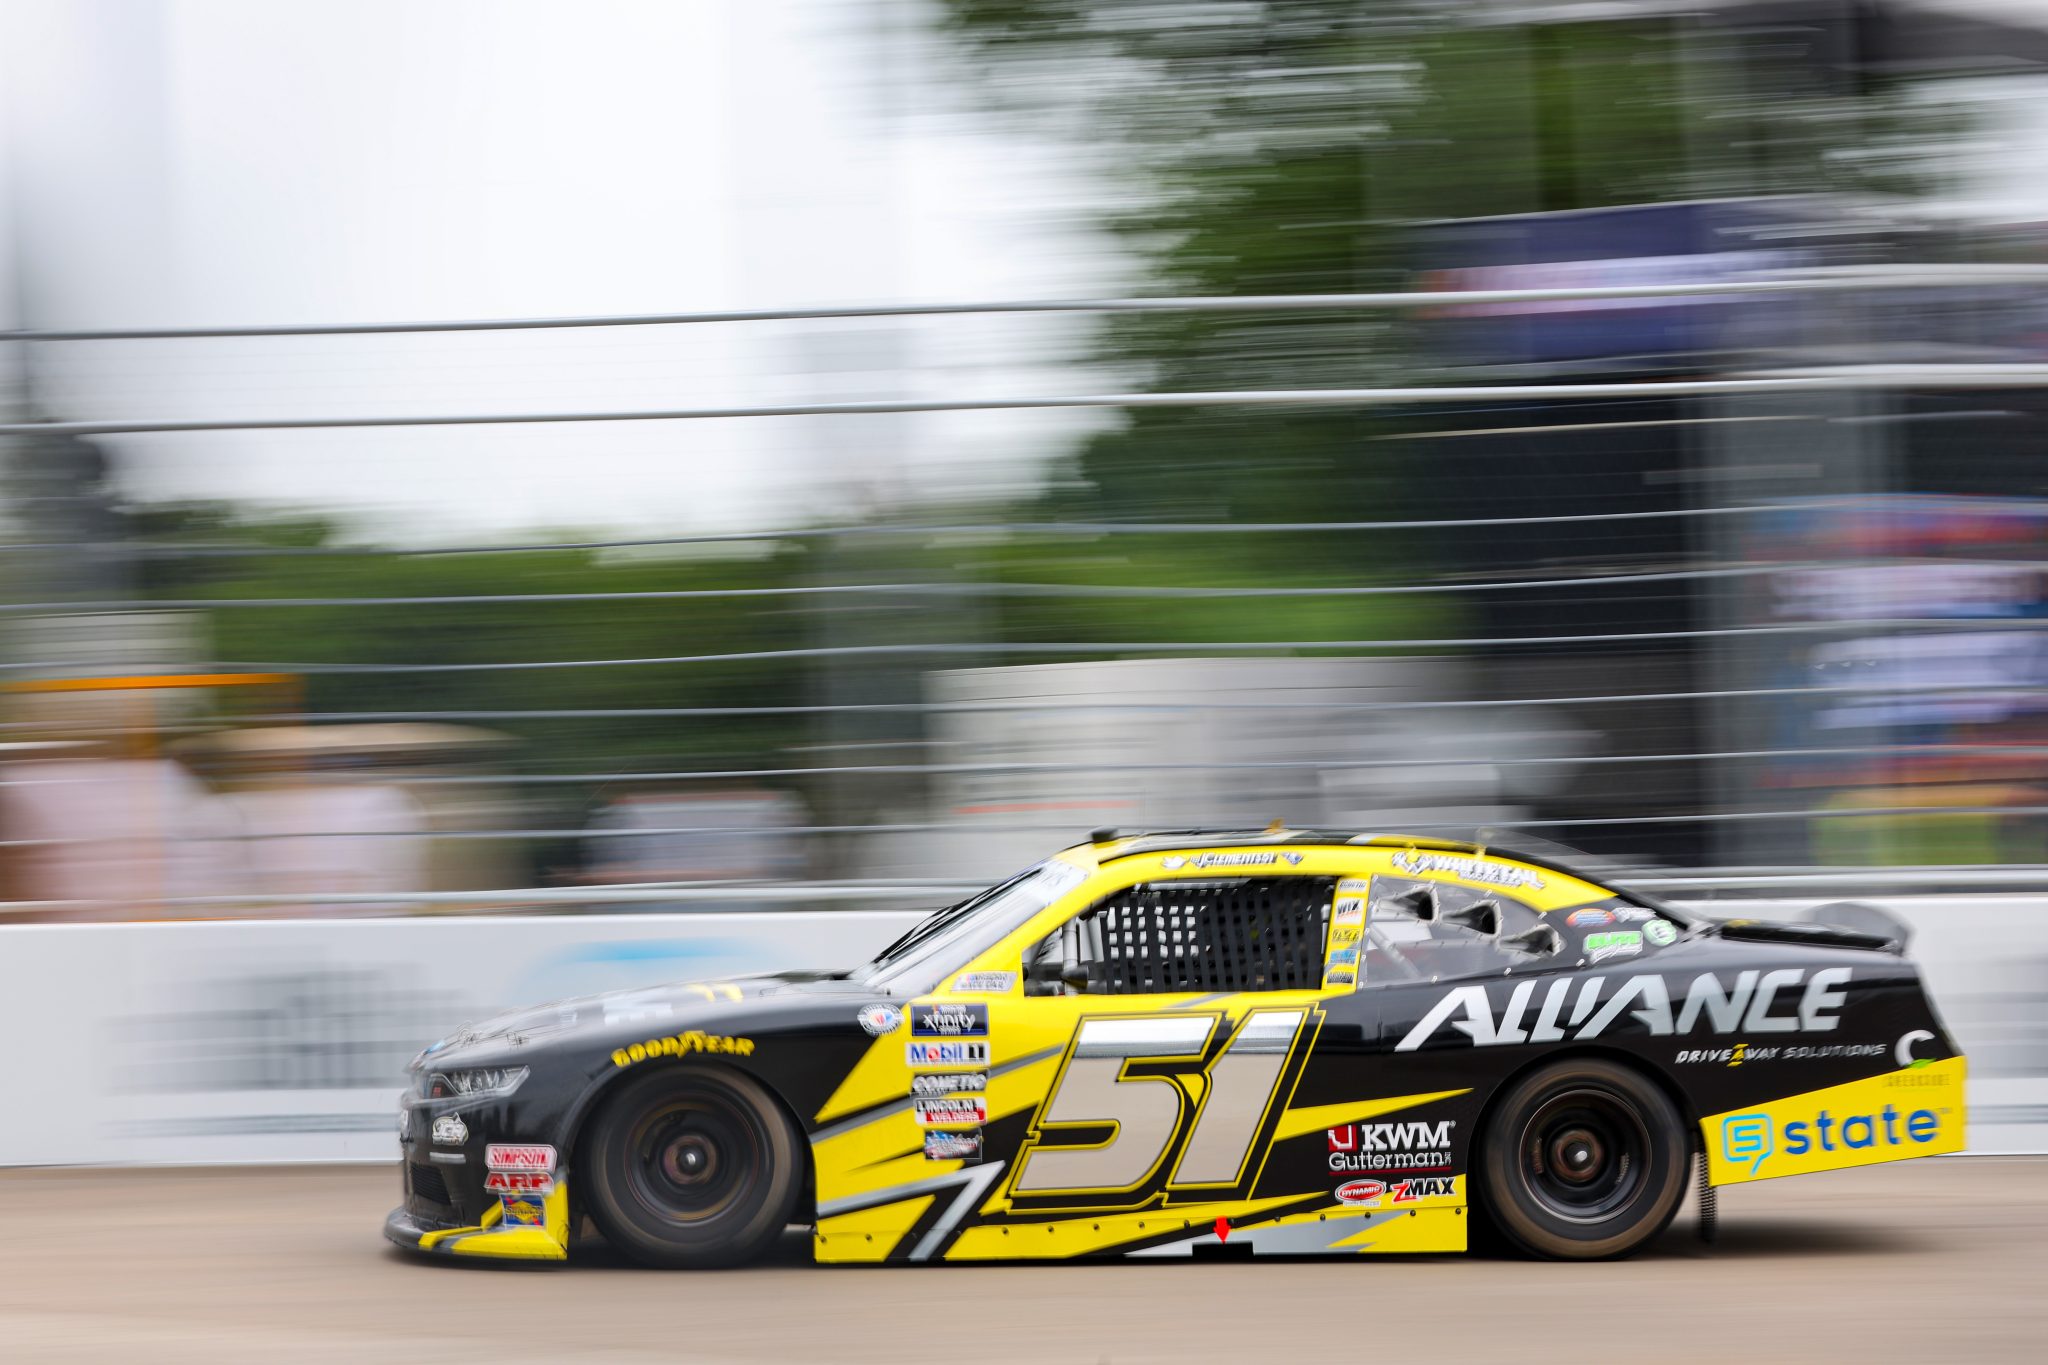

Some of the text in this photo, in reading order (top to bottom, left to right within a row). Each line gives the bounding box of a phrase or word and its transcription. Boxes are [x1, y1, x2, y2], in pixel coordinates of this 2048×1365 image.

[1395, 967, 1852, 1052] ALLIANCE
[611, 1030, 755, 1067] GOODYEAR
[911, 1044, 962, 1060] Mobil
[1782, 1043, 1887, 1059] SOLUTIONS
[917, 1100, 975, 1113] LINCOLN
[1010, 1007, 1312, 1200] 51
[1362, 1121, 1451, 1151] KWM
[1784, 1103, 1939, 1155] state
[1328, 1151, 1445, 1171] Gutterman
[486, 1172, 552, 1189] ARP
